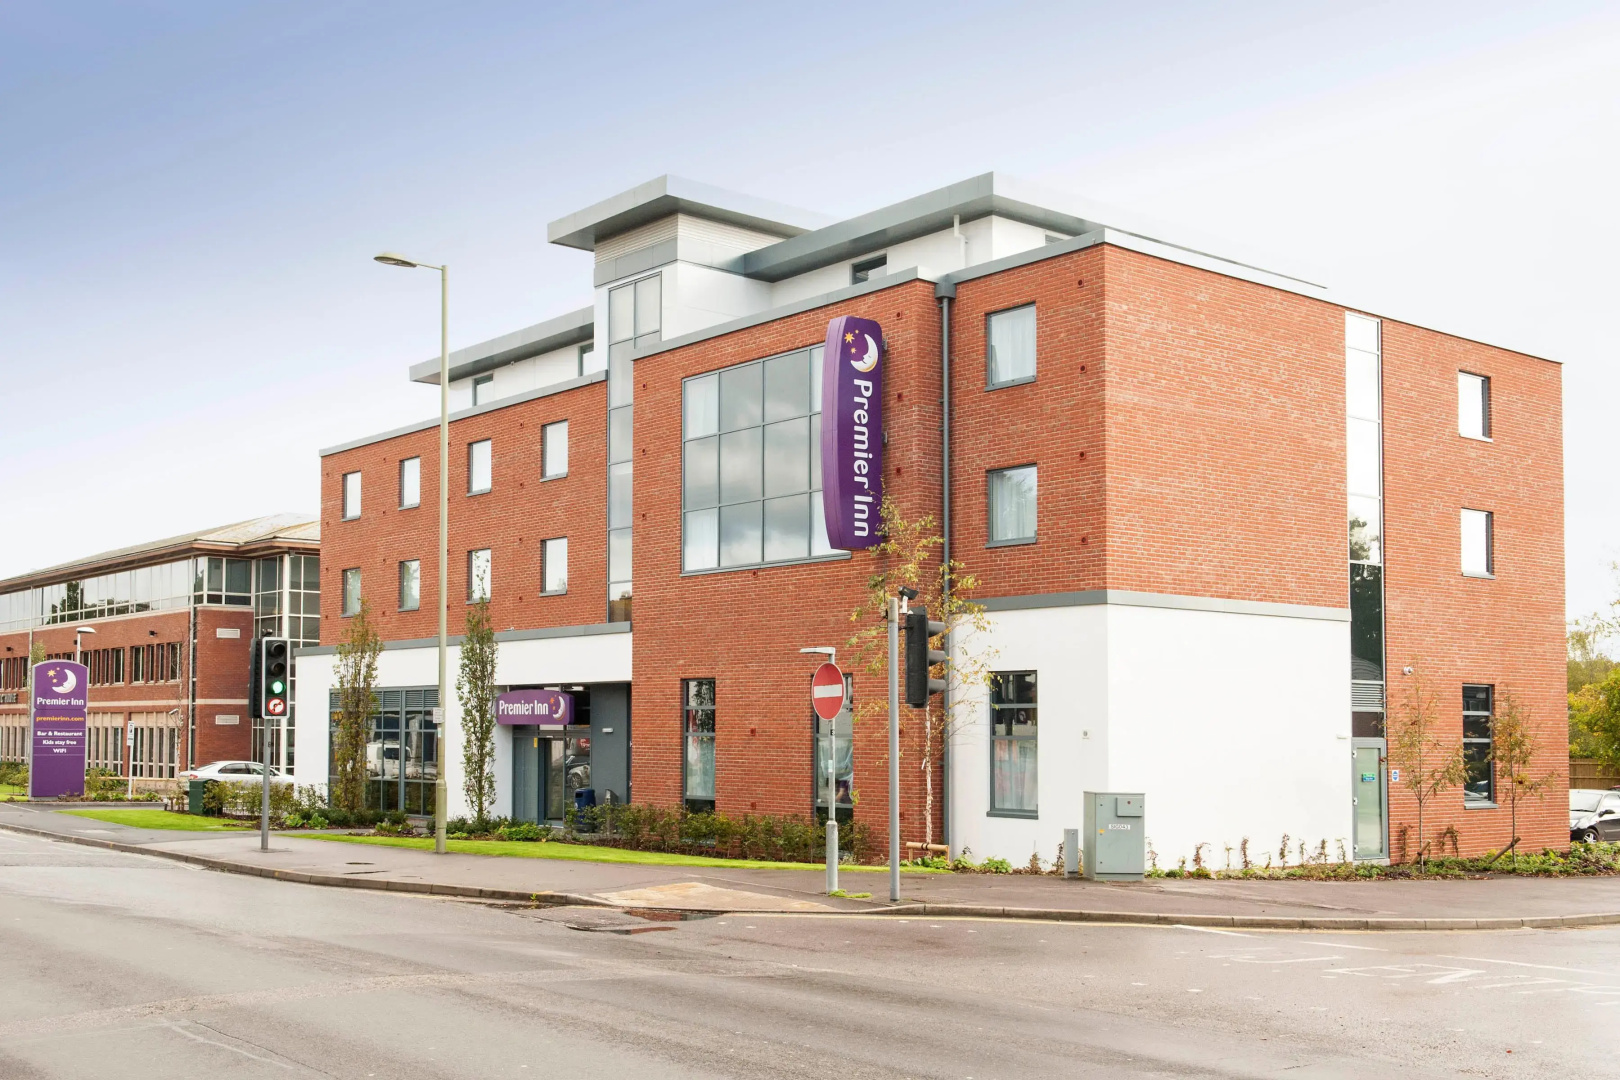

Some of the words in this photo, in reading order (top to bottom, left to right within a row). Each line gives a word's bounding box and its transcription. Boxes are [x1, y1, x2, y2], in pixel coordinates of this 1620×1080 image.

[853, 378, 873, 489] Premier
[853, 494, 873, 537] Inn
[37, 697, 70, 705] Premier
[499, 699, 533, 715] Premier
[534, 699, 549, 715] Inn
